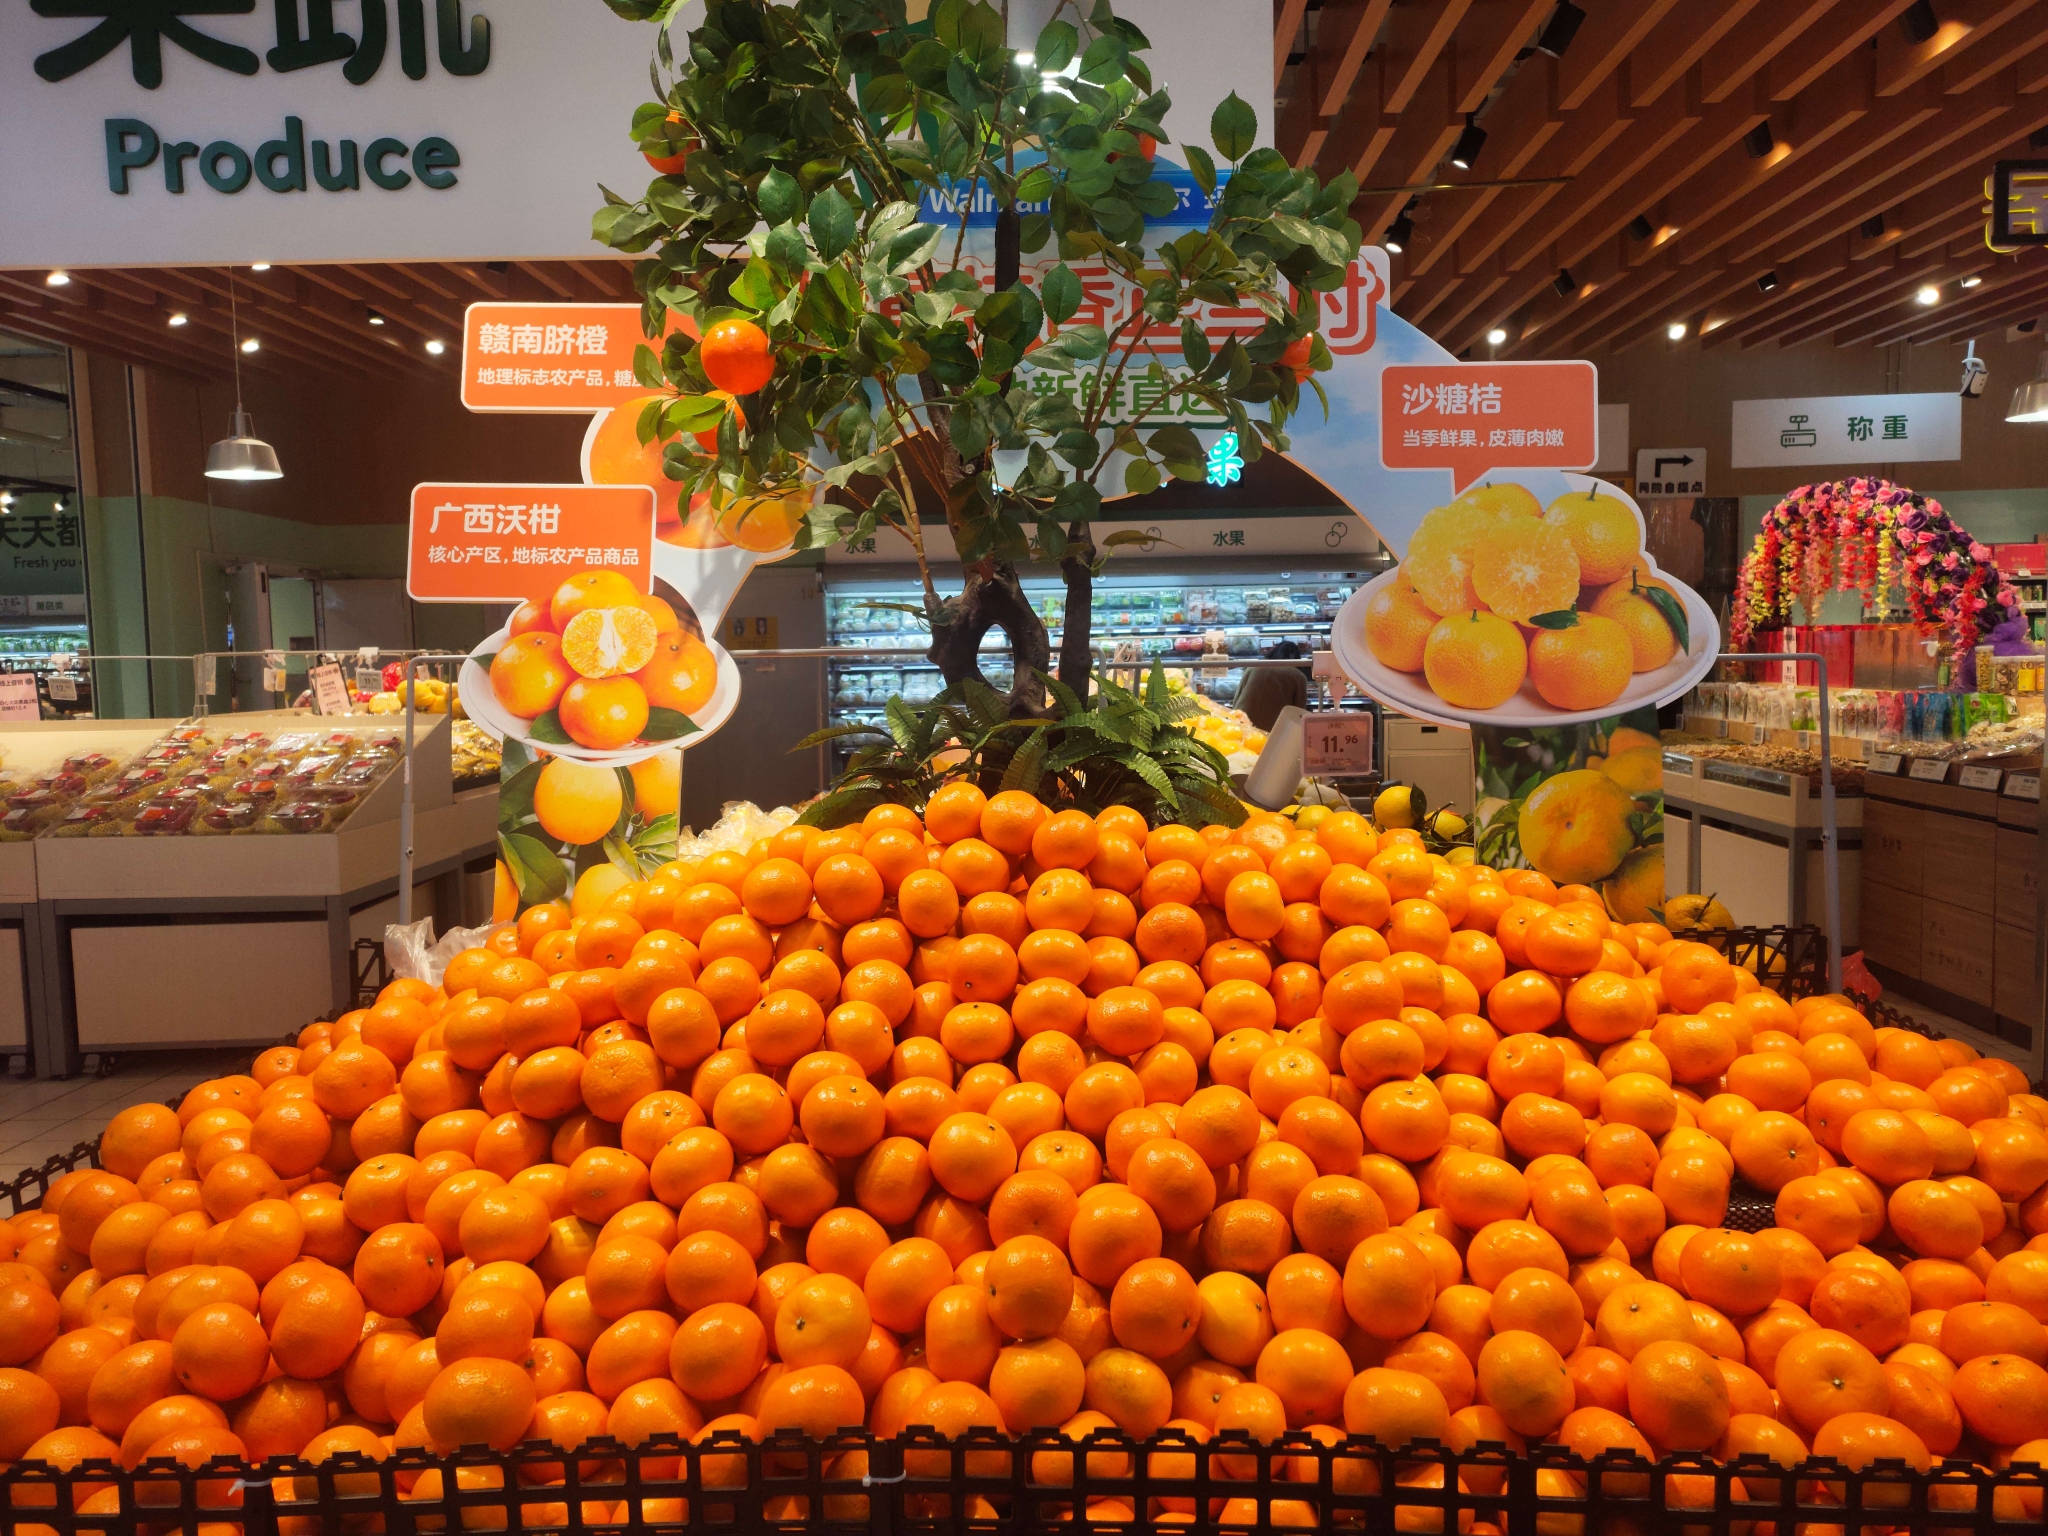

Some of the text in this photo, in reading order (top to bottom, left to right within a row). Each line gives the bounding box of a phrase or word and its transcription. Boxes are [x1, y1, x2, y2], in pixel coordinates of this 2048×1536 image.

[104, 116, 460, 195] Produce
[929, 188, 1052, 213] Walar
[478, 323, 608, 355] 赣南脐橙
[1402, 382, 1503, 415] 沙糖桔
[1847, 415, 1909, 442] 称重
[429, 503, 562, 535] 广西沃柑
[1213, 530, 1245, 547] 水果
[13, 555, 76, 571] Fresh you
